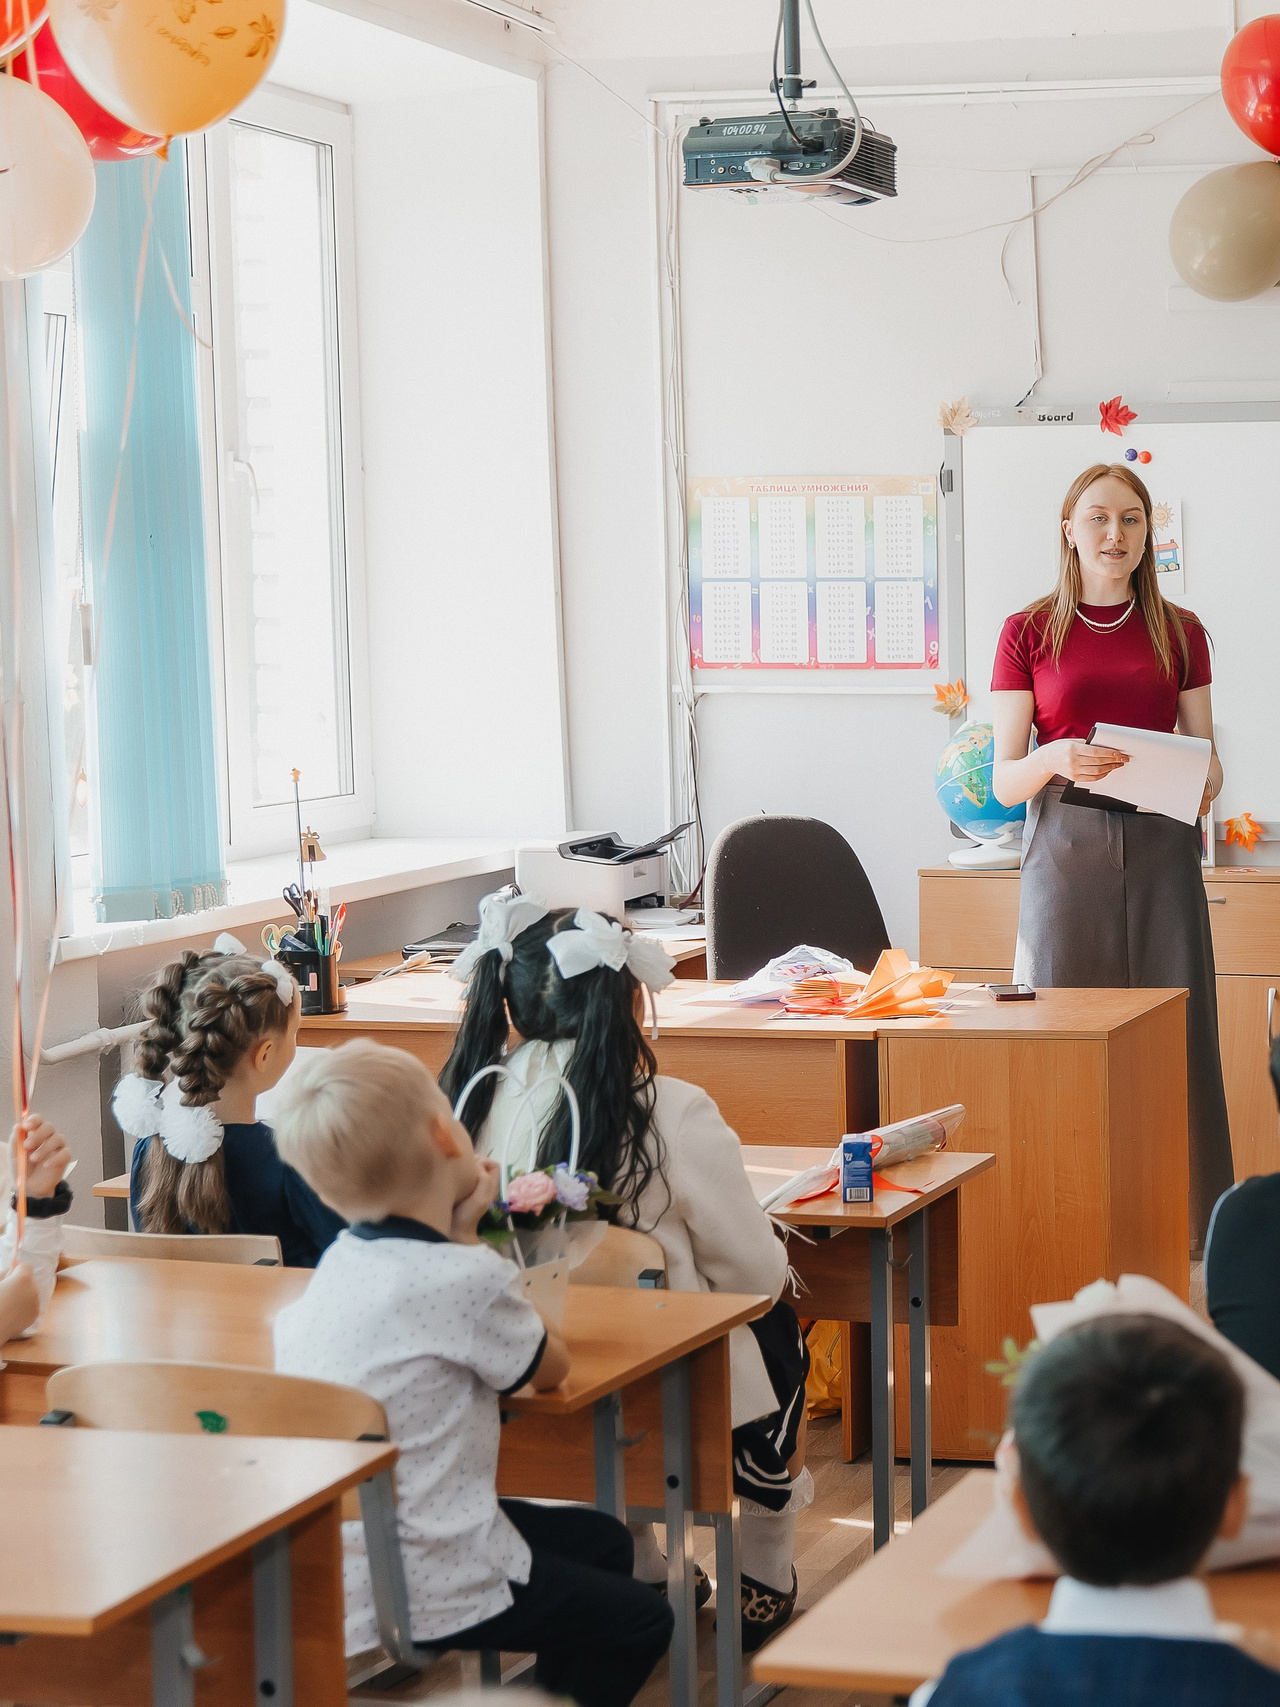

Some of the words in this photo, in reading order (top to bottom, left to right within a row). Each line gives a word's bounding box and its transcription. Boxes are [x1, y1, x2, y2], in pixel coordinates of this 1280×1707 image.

[722, 123, 766, 136] 1040094
[749, 484, 798, 493] ТАБЛИЦА
[801, 484, 869, 493] УМНОЖЕНИЯ
